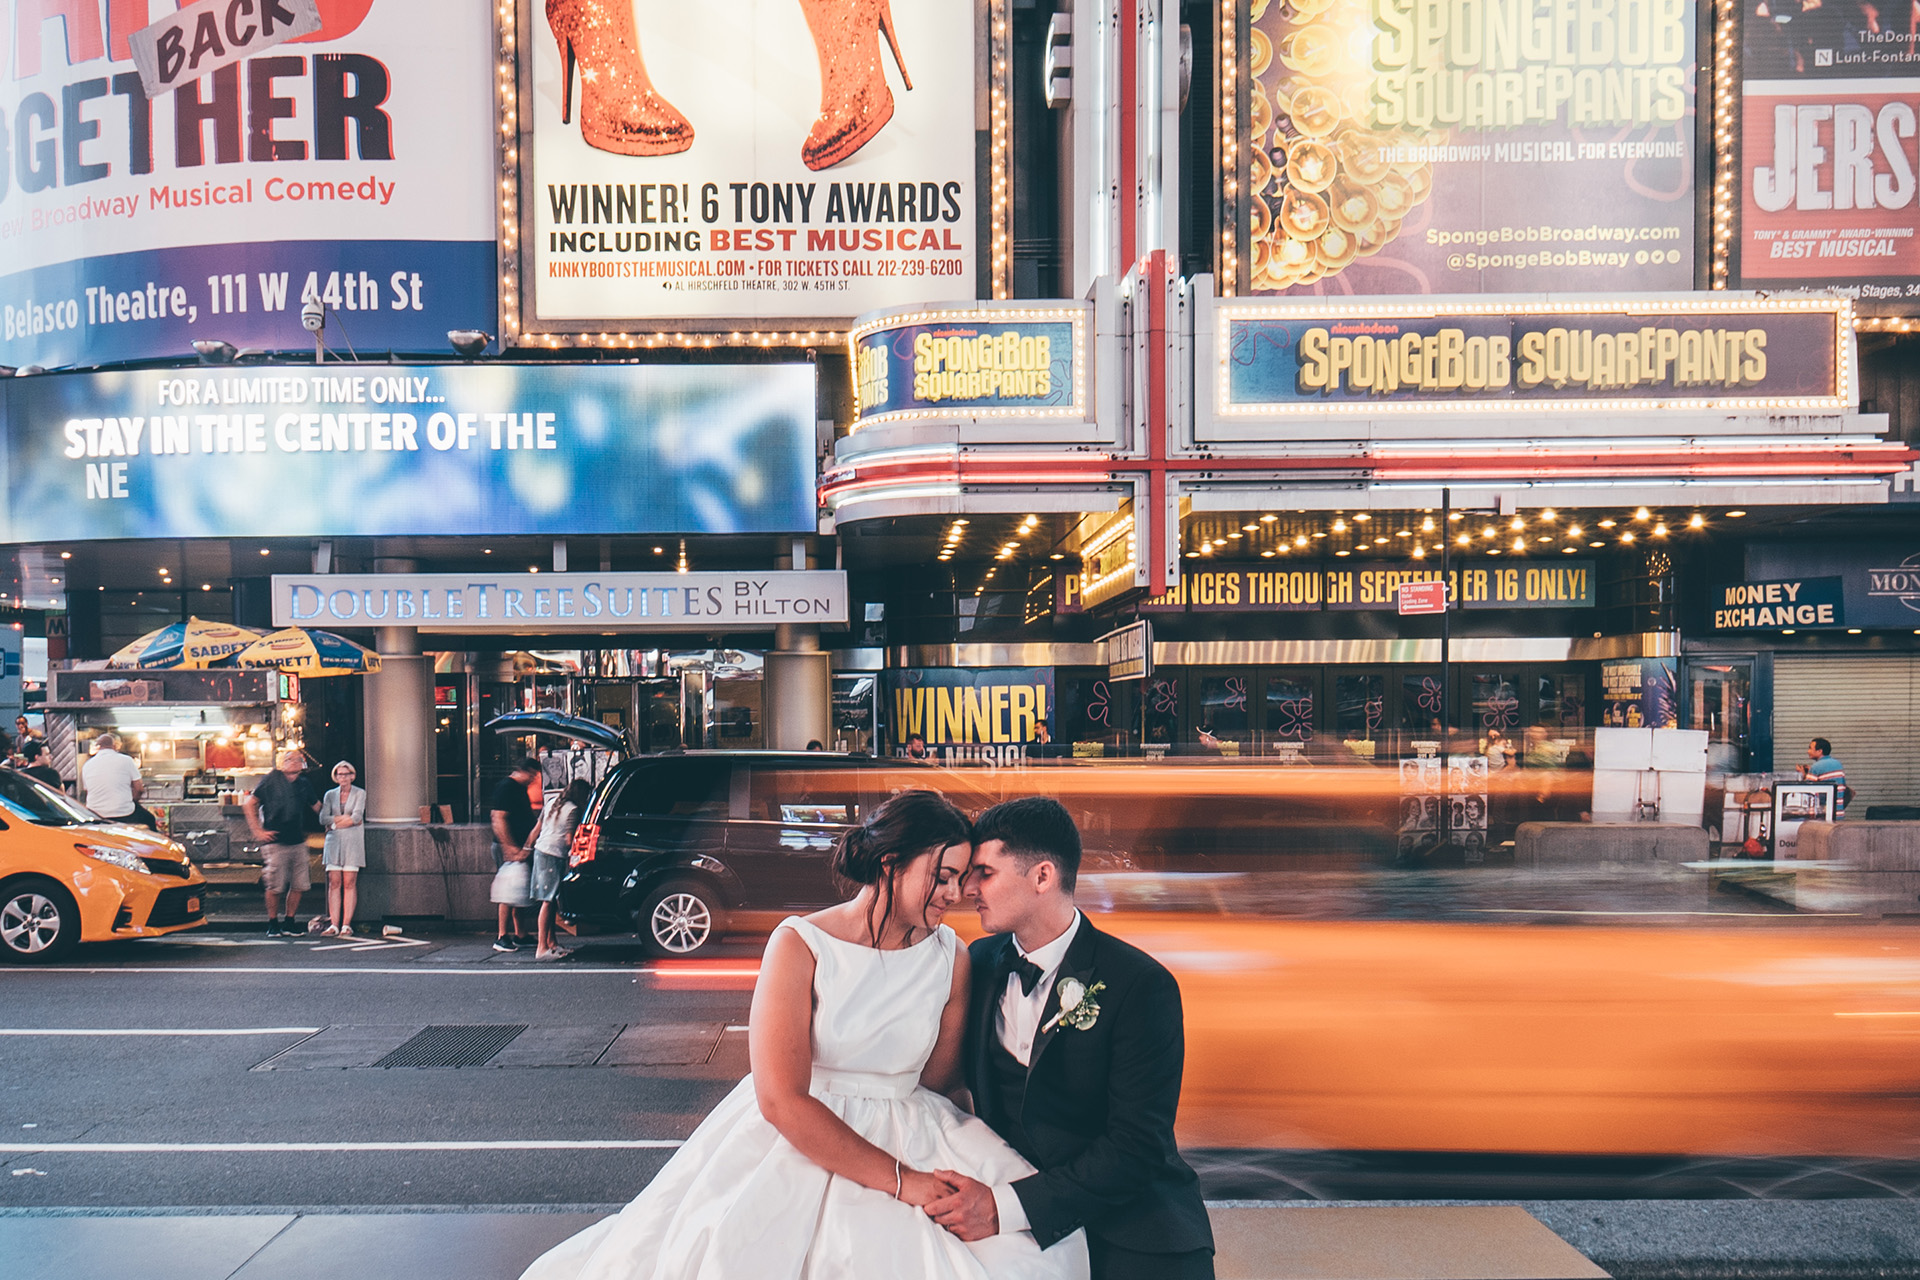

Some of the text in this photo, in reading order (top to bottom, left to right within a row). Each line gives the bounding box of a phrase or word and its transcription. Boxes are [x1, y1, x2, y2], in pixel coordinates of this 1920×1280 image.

[155, 0, 296, 83] BACK
[1371, 65, 1685, 135] SQUAREPANTS
[0, 53, 395, 204] GETHER
[1378, 141, 1684, 163] THE BROADWAY MUSICAL FOR EVERYONE
[1753, 102, 1920, 212] JERS
[31, 195, 139, 231] Broadway
[150, 178, 252, 210] Musical
[265, 176, 396, 205] Comedy
[548, 181, 961, 224] WINNER! 6 TONY AWARDS
[550, 228, 962, 253] INCLUDING BEST MUSICAL
[1426, 225, 1680, 246] SpongeBobBroadway.com
[1770, 239, 1897, 258] BEST MUSICAL
[1782, 230, 1790, 240] &
[1838, 228, 1914, 239] AWARD-WINNING
[549, 259, 963, 278] KINKYBOOTSTHEMUSICAL.COM FOR TICKETS CALL 212-239-6200
[1447, 250, 1630, 271] @SpongeBobBway
[675, 281, 685, 291] AL
[688, 280, 739, 291] HIRSCHFELD
[782, 280, 798, 291] 302
[814, 280, 836, 291] 45TH
[1861, 284, 1903, 299] Stages,
[5, 270, 424, 341] Belasco Theatre, 111 W 44th St
[913, 331, 1050, 372] SPONGEBOB
[1298, 327, 1767, 395] SPONGEBOB SQUAREPANTS
[158, 376, 445, 406] FOR A LIMITED TIME ONLY...
[913, 369, 1050, 402] SQUAREPANTS
[64, 411, 557, 459] STAY IN THE CENTER OF THE
[86, 461, 129, 499] NE
[735, 580, 769, 597] BY
[1247, 571, 1353, 604] THROUGH
[1495, 569, 1519, 602] 16
[1525, 568, 1586, 601] ONLY!
[1725, 583, 1801, 605] MONEY
[735, 598, 830, 616] HILTON
[1715, 604, 1834, 629] EXCHANGE
[895, 685, 1046, 744] WINNER!
